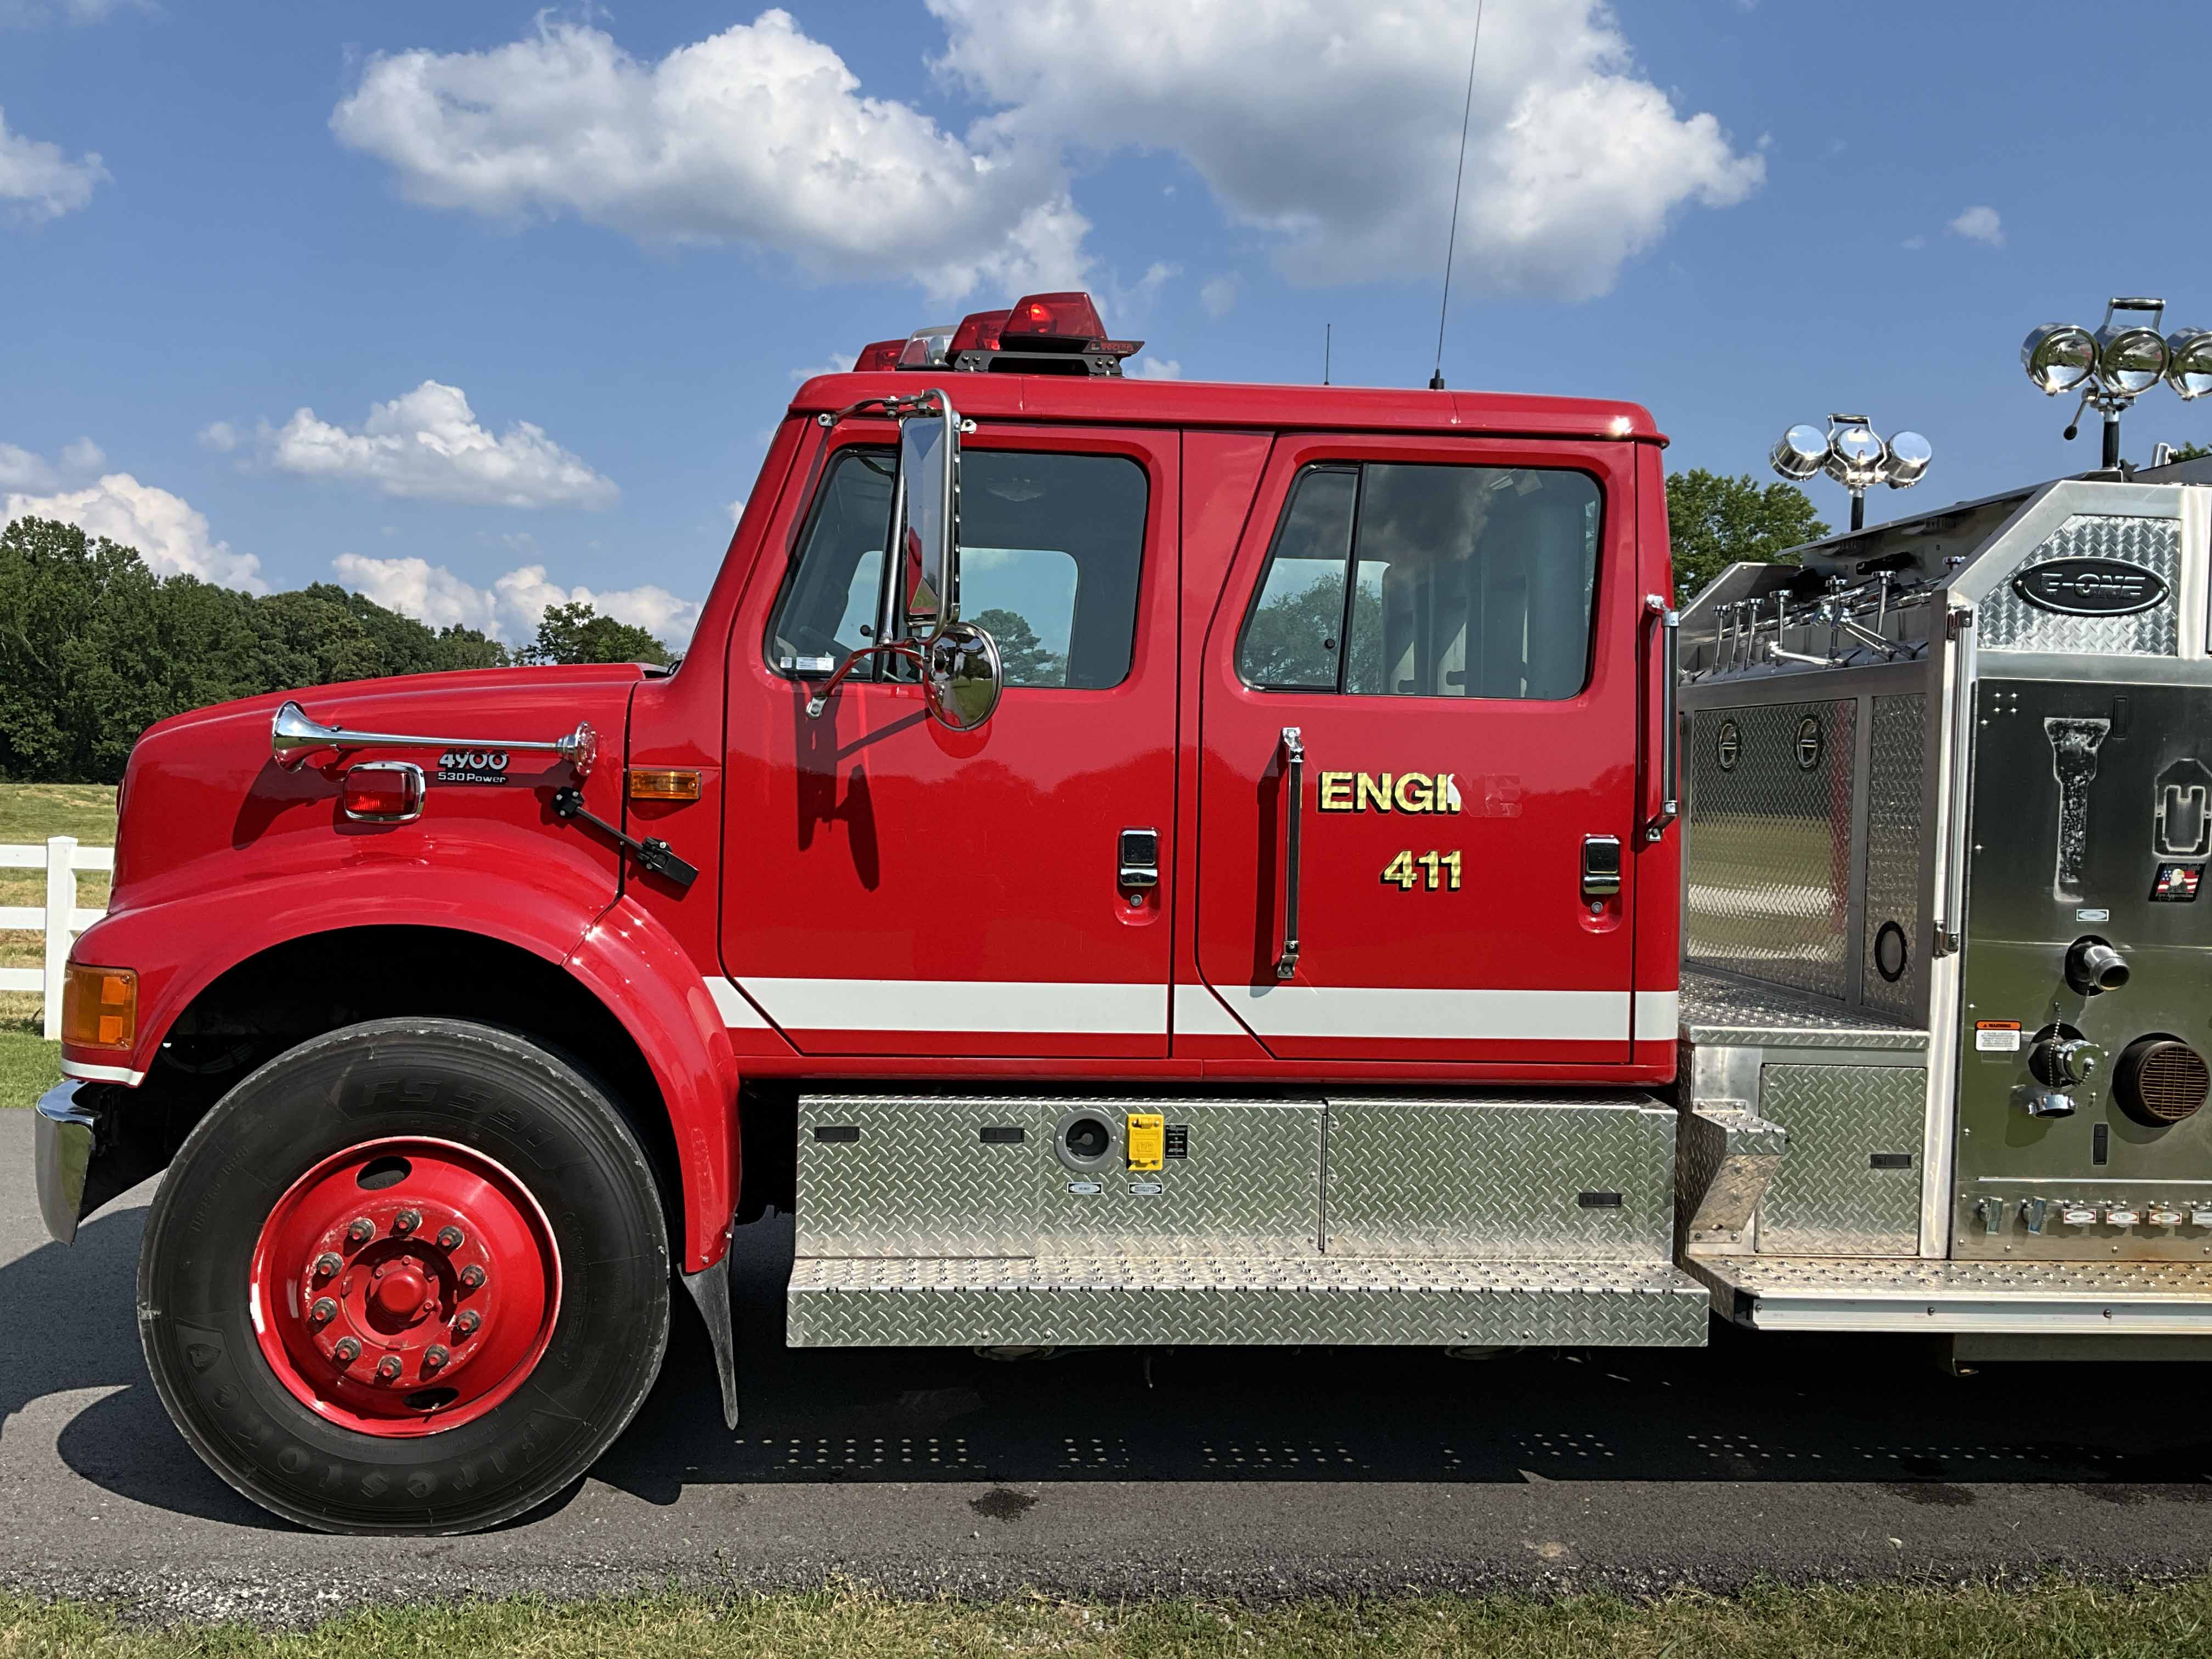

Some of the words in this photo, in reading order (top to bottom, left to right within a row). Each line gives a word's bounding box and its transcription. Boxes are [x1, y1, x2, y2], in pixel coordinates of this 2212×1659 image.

[2038, 573, 2146, 599] E-ONE
[439, 749, 509, 771] 4900
[1380, 850, 1462, 891] 411
